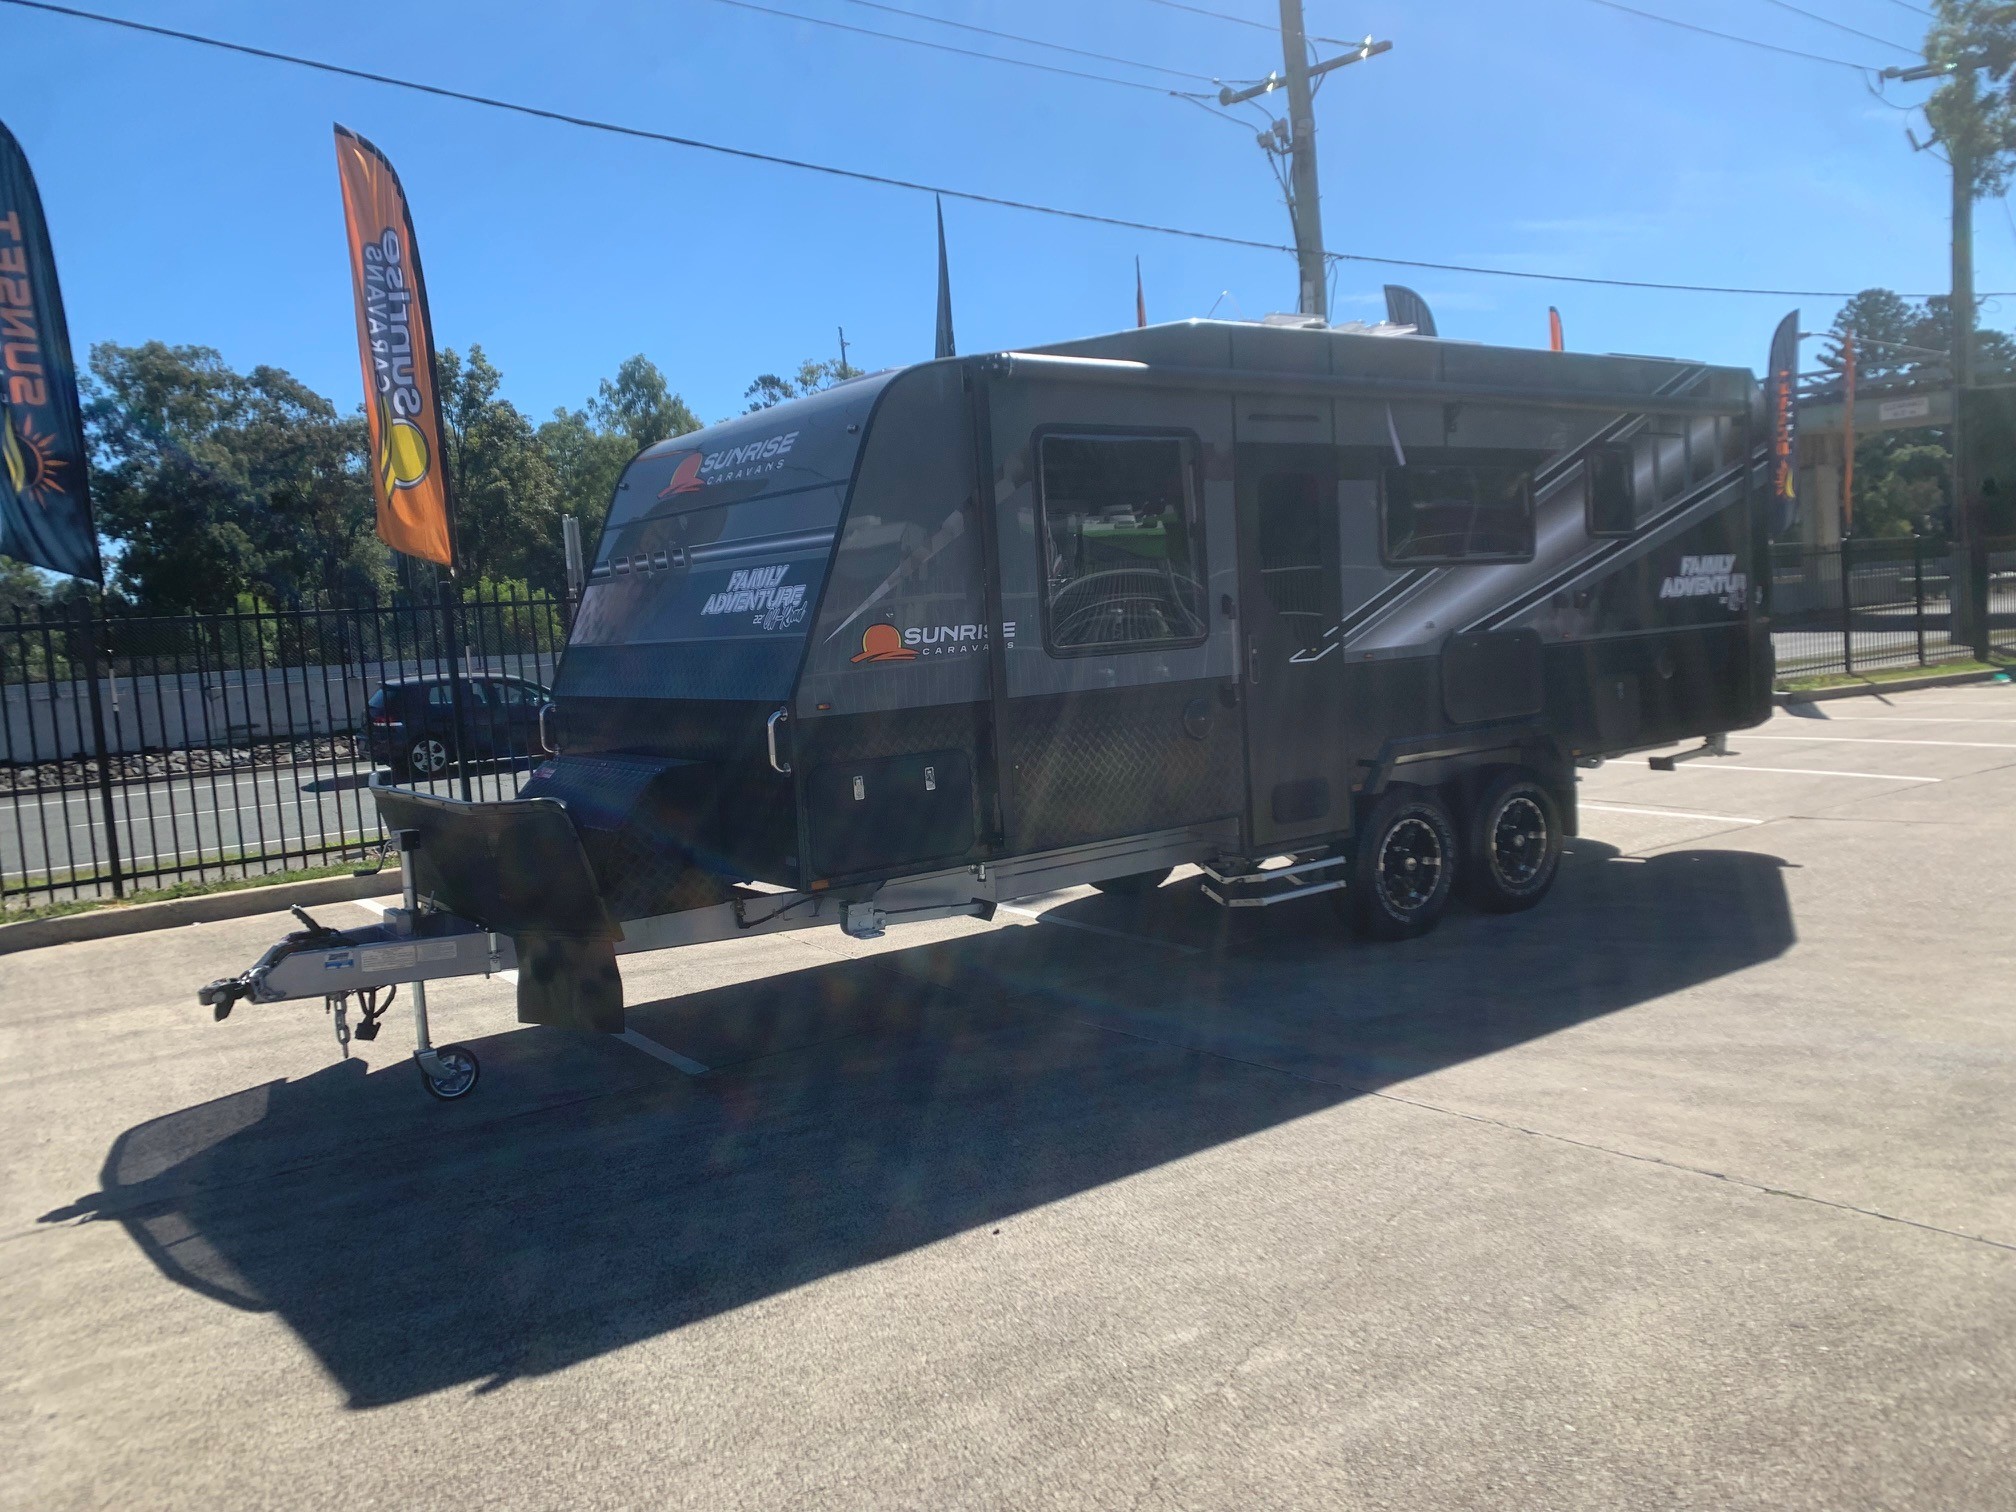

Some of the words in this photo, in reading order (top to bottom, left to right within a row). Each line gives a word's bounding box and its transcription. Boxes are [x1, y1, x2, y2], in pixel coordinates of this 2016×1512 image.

[701, 431, 799, 473] SUNRISE
[706, 459, 784, 485] CARAVANS
[726, 564, 789, 592] FAMILY
[1680, 554, 1736, 576] FAMILY
[1660, 573, 1747, 599] ADVENTUR
[700, 584, 806, 615] ADVENTURE
[922, 641, 1014, 656] CARAVAS
